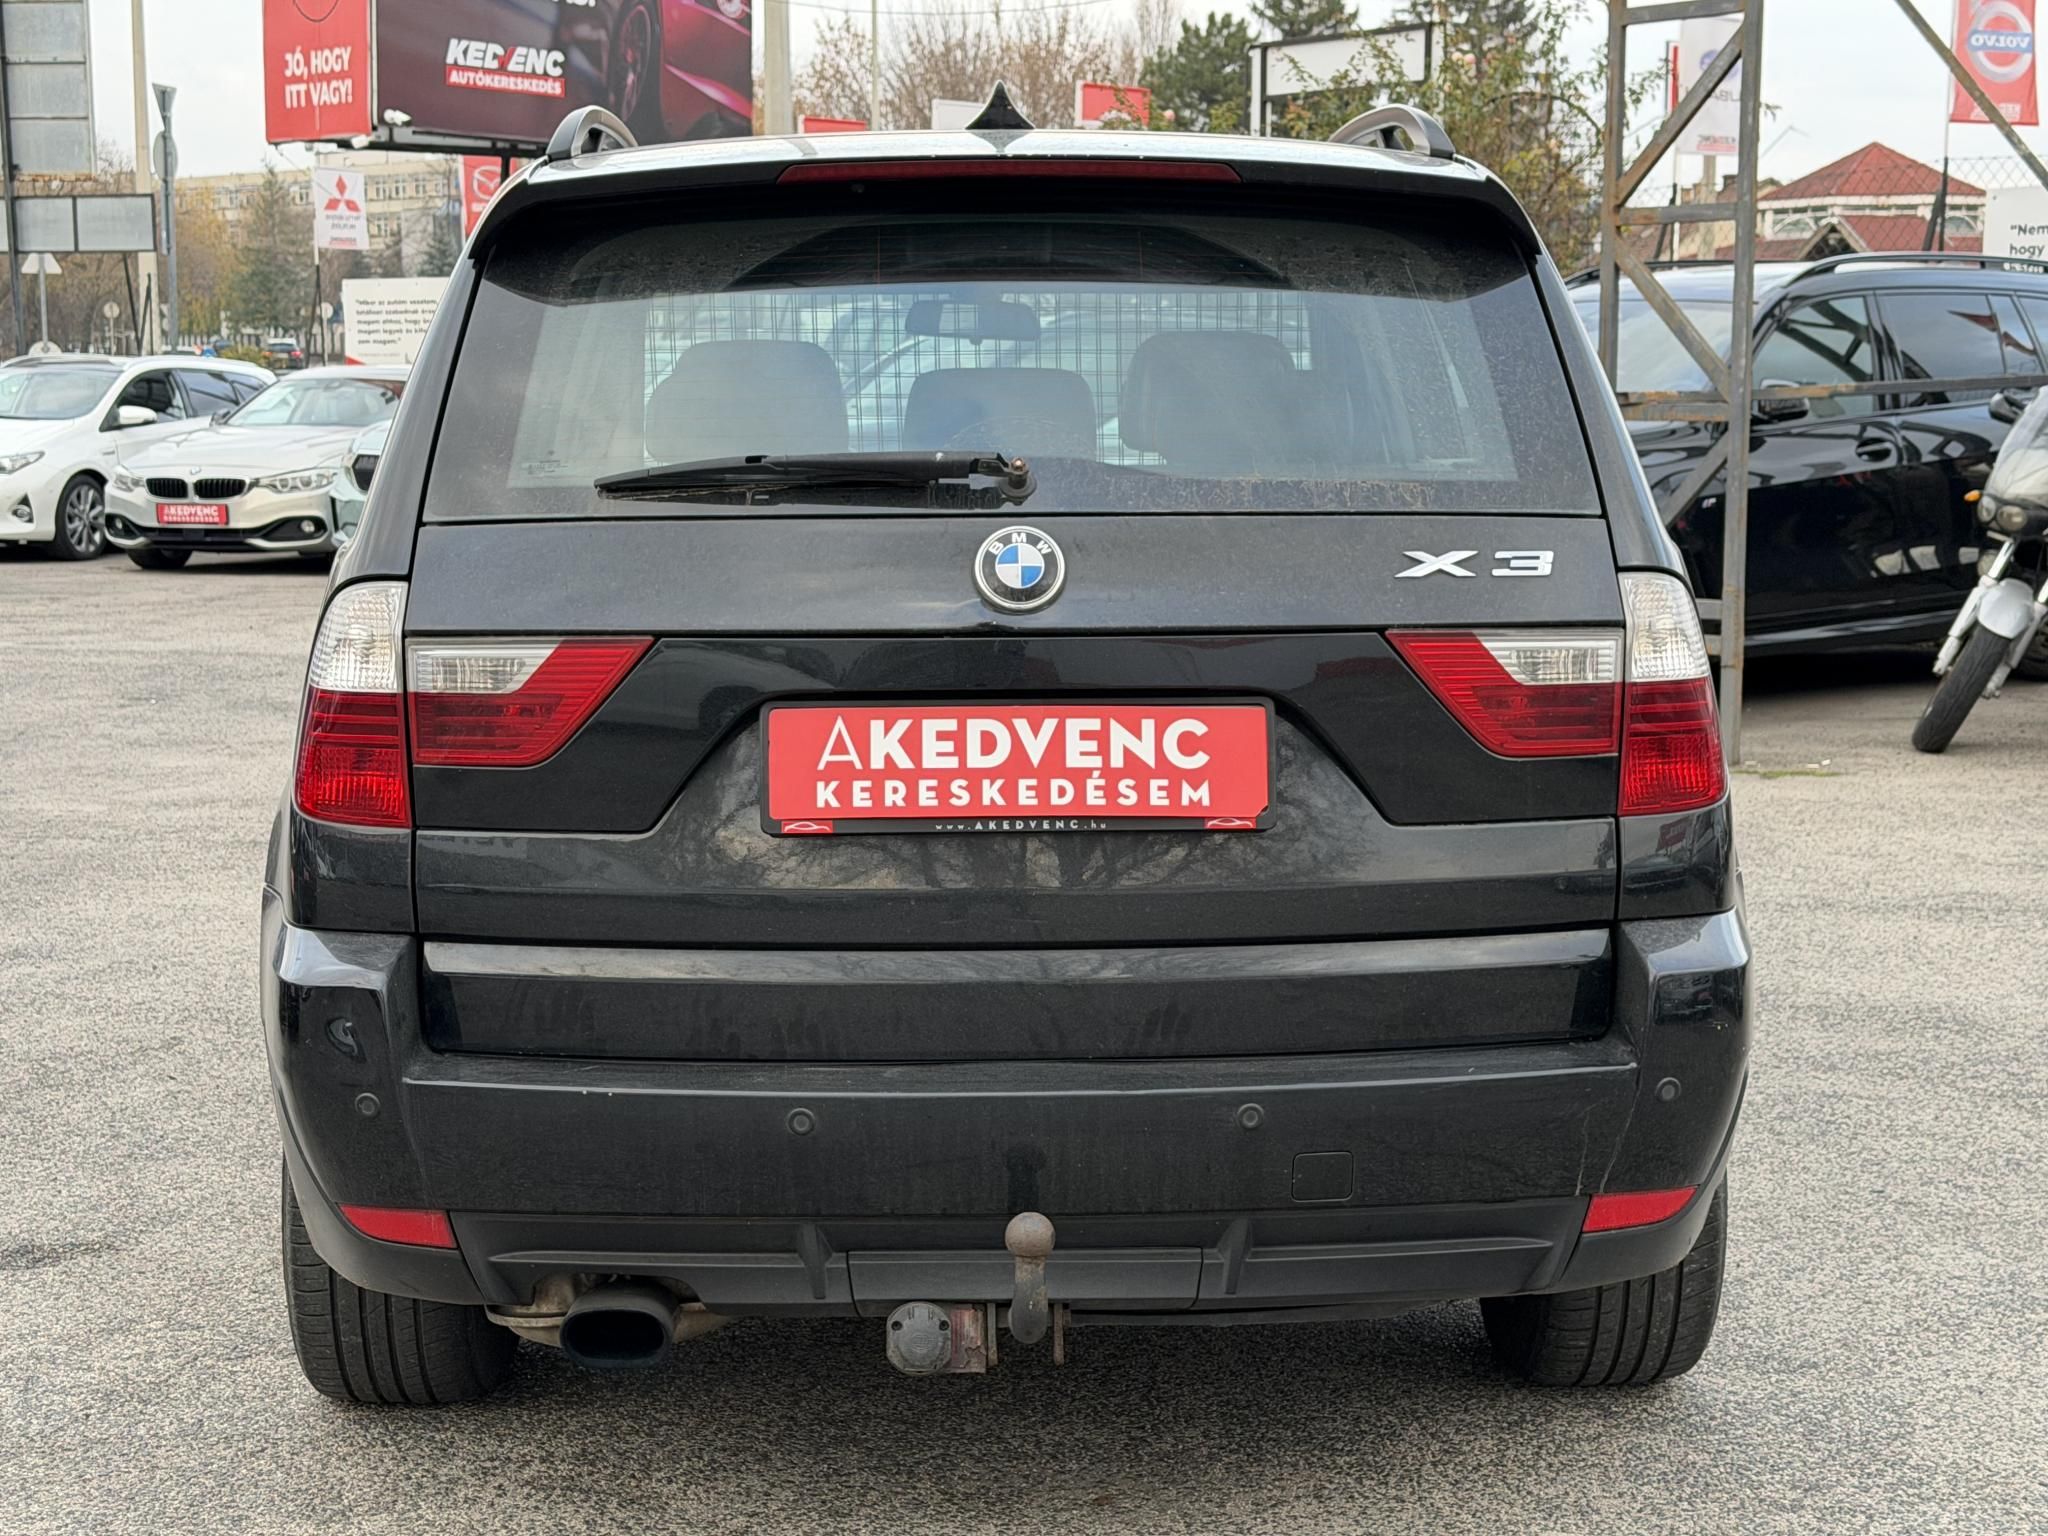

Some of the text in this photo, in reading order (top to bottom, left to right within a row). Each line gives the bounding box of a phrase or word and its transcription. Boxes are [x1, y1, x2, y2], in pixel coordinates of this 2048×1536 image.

[284, 46, 351, 77] JÓ, HOGY
[285, 79, 352, 109] ITT VAGY!
[449, 70, 562, 95] AUTÓKERESKEDÉS
[2009, 243, 2045, 258] hogy
[988, 532, 1052, 555] BMW
[817, 715, 1211, 770] AKEDVENC
[816, 770, 1211, 808] KERESKEDÉSEM
[935, 819, 1107, 831] www.AKEDVENC.hu
